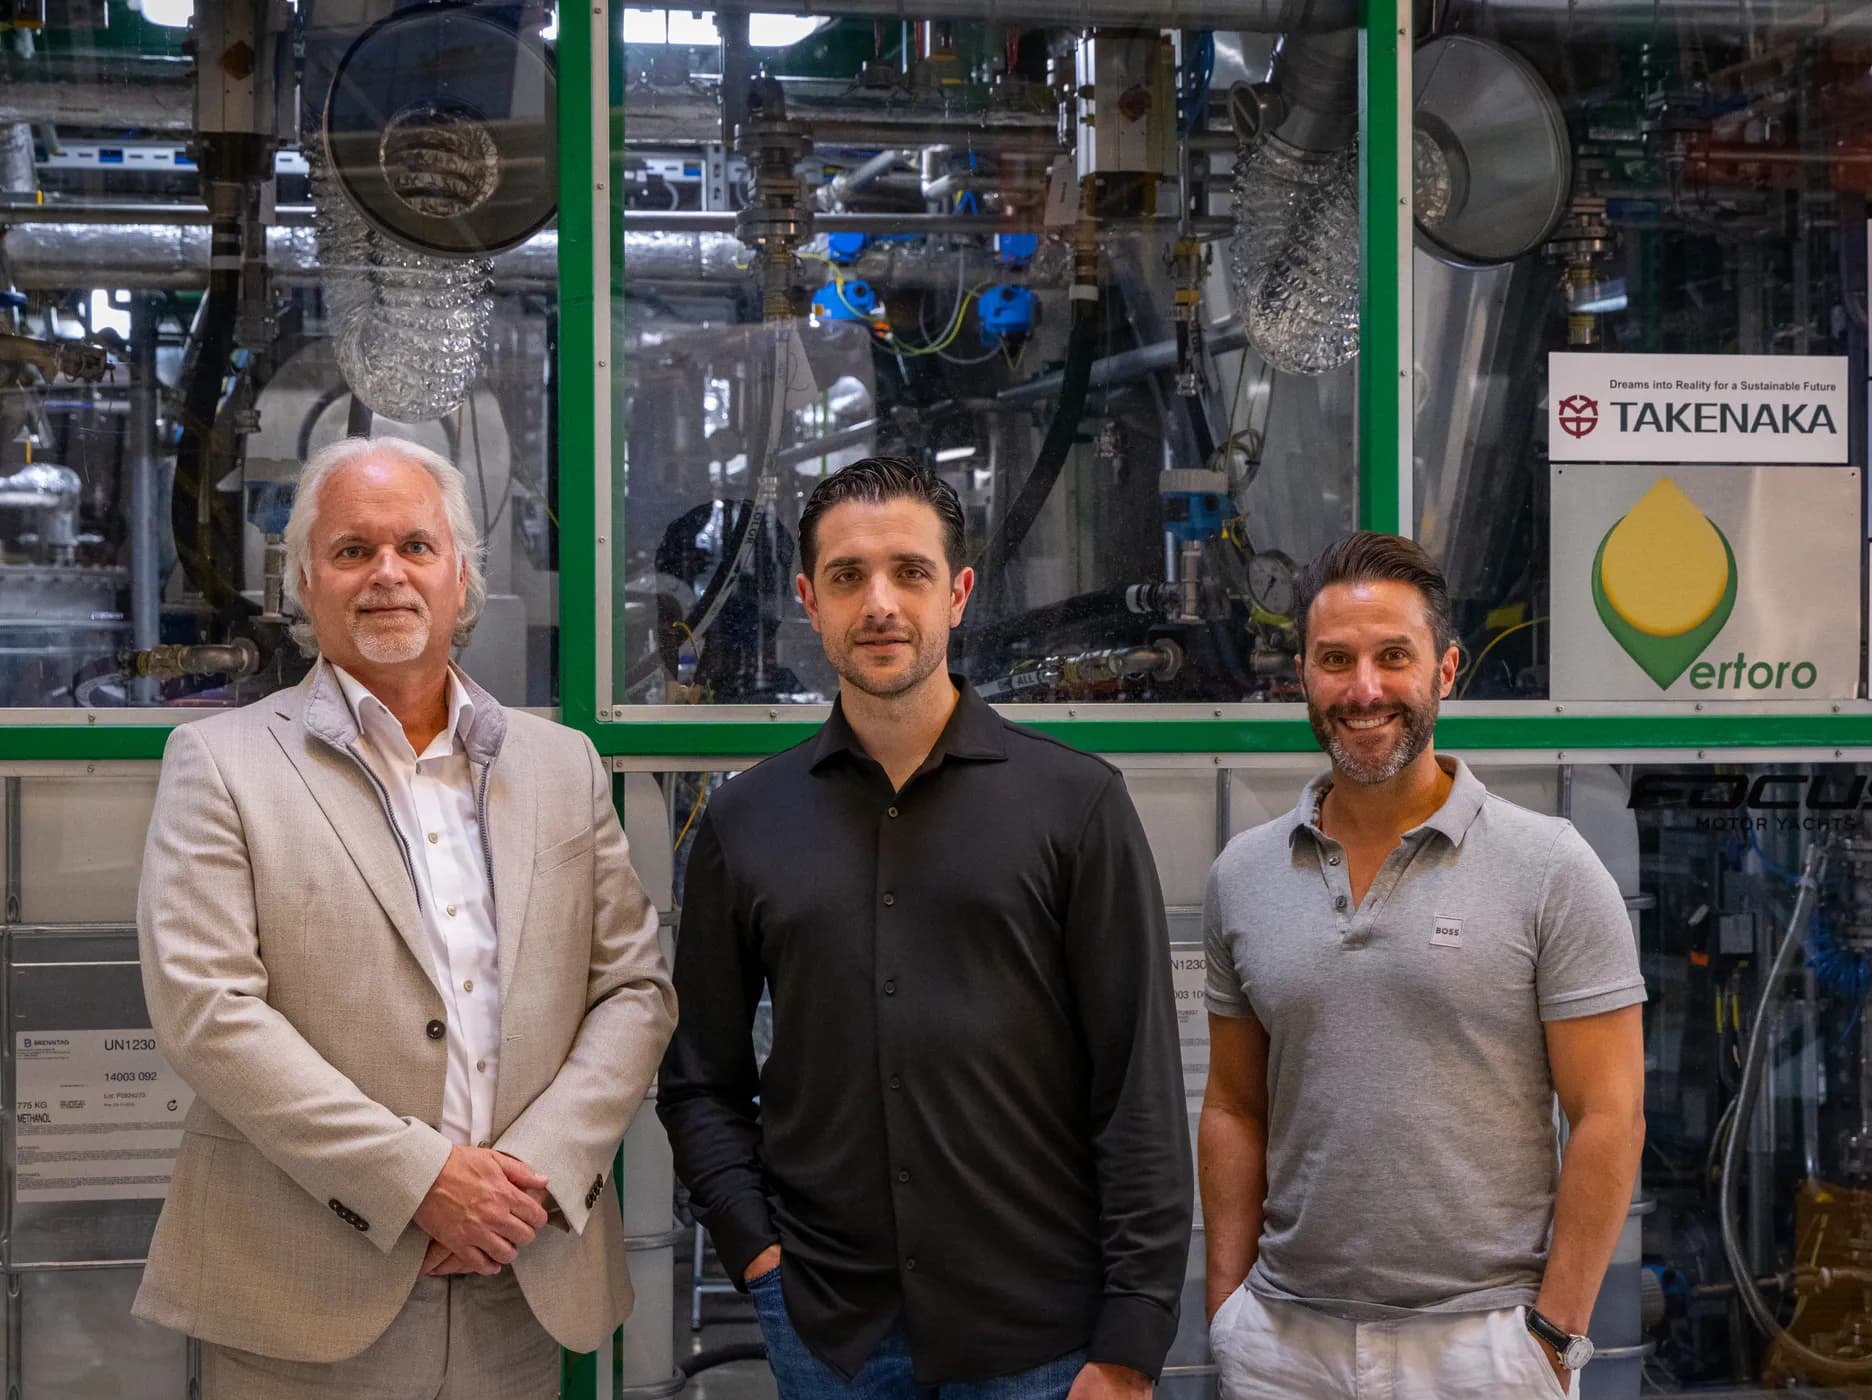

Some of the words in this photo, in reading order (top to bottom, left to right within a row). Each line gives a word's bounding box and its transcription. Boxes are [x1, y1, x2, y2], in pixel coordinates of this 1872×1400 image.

[1609, 380, 1649, 390] Dreams
[1653, 380, 1672, 390] into
[1676, 380, 1711, 392] Reality
[1714, 380, 1728, 390] for
[1740, 381, 1800, 391] Sustainable
[1804, 382, 1837, 392] Future
[1610, 402, 1837, 434] TAKENAKA
[1627, 775, 1872, 809] FOCU
[1697, 817, 1767, 831] MOTOR
[1777, 817, 1856, 831] YACHTS
[1435, 927, 1459, 936] BOSS
[1171, 959, 1207, 970] N1230
[104, 1039, 156, 1051] UN1230
[105, 1072, 135, 1081] 14003
[138, 1072, 157, 1081] 092
[17, 1101, 32, 1109] 775
[34, 1101, 47, 1109] KG
[17, 1112, 51, 1123] METHANOL
